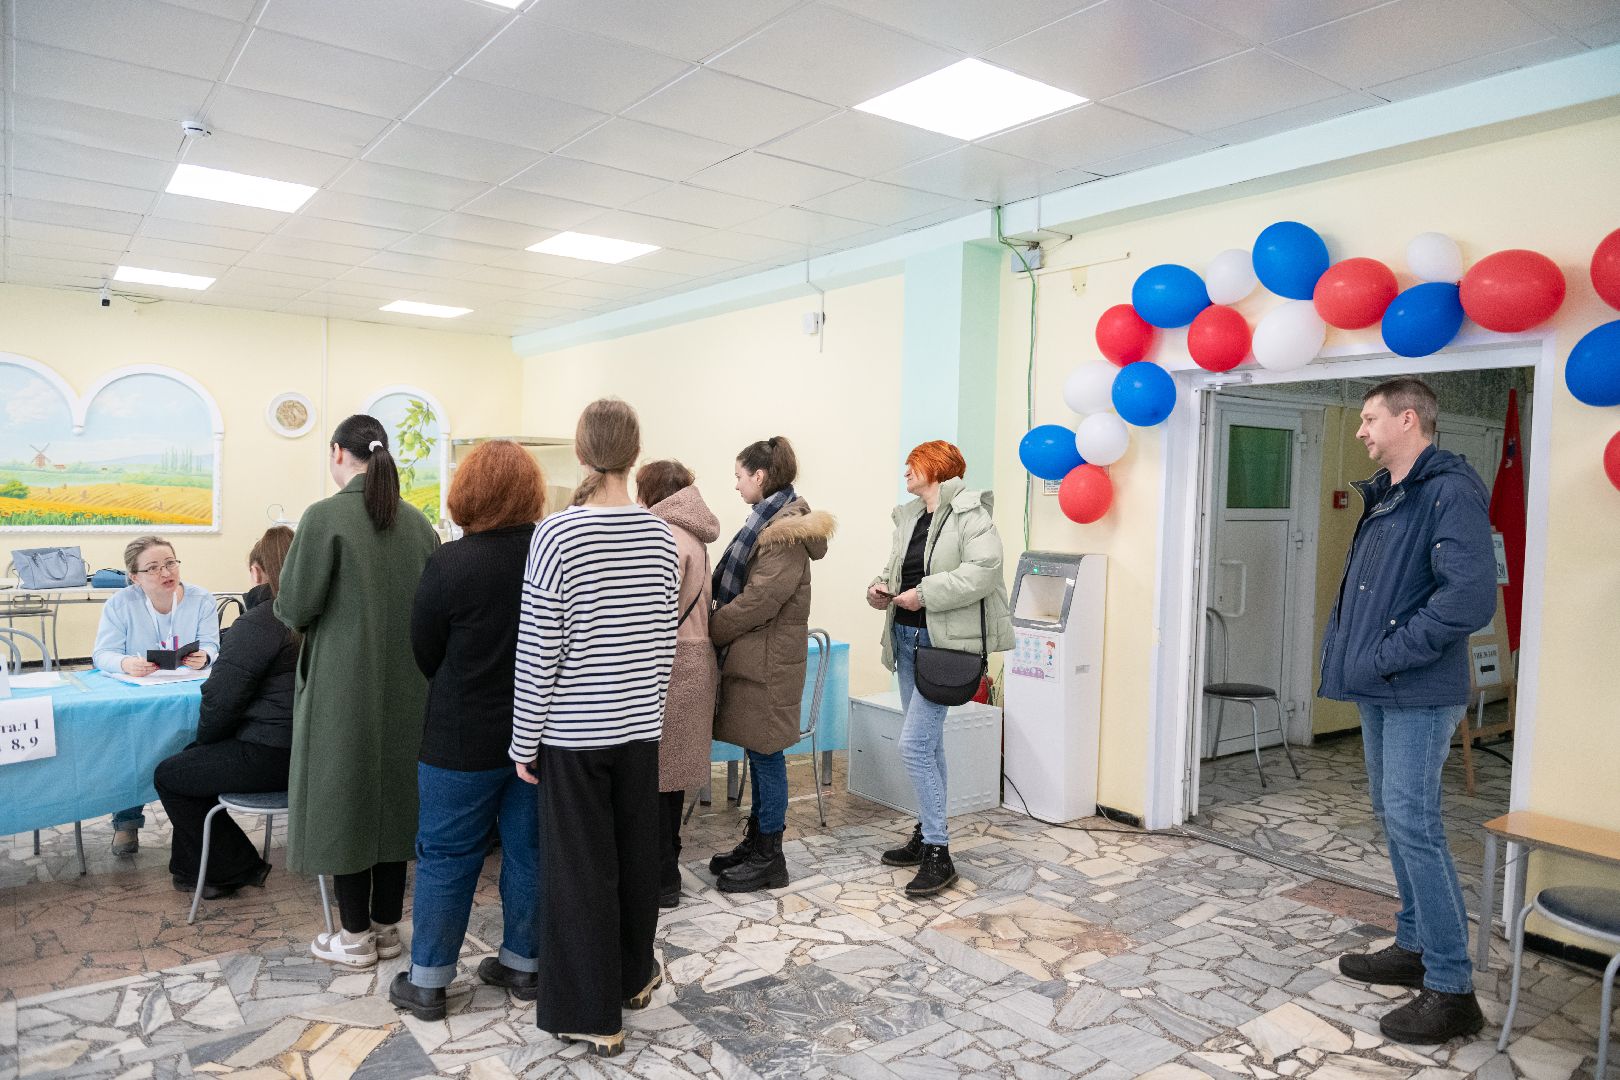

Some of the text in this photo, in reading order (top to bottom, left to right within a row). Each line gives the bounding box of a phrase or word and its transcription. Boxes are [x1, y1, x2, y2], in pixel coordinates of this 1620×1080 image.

[34, 718, 39, 730] 1
[11, 736, 39, 751] 8, 9
